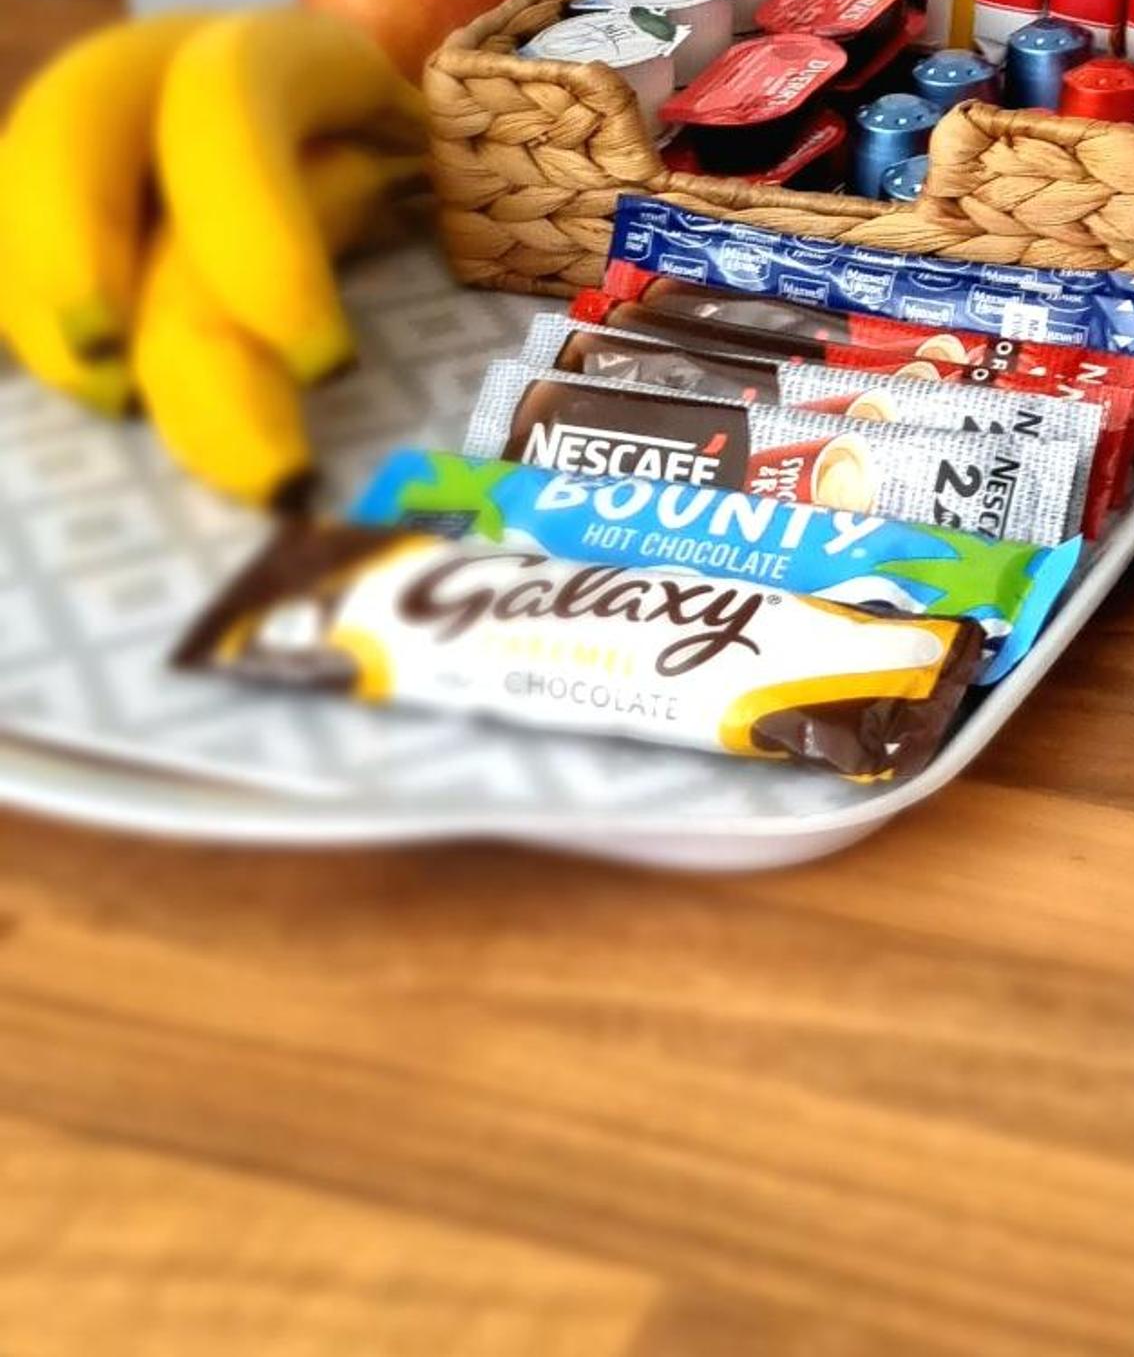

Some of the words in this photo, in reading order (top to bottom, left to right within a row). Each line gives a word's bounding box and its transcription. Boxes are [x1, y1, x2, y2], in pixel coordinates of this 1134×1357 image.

[534, 470, 887, 557] BOUNTY
[583, 521, 639, 551] HOT
[638, 528, 791, 581] CHOCOLATE
[396, 553, 763, 678] Galaxy
[502, 669, 681, 722] CHOCOLATE
